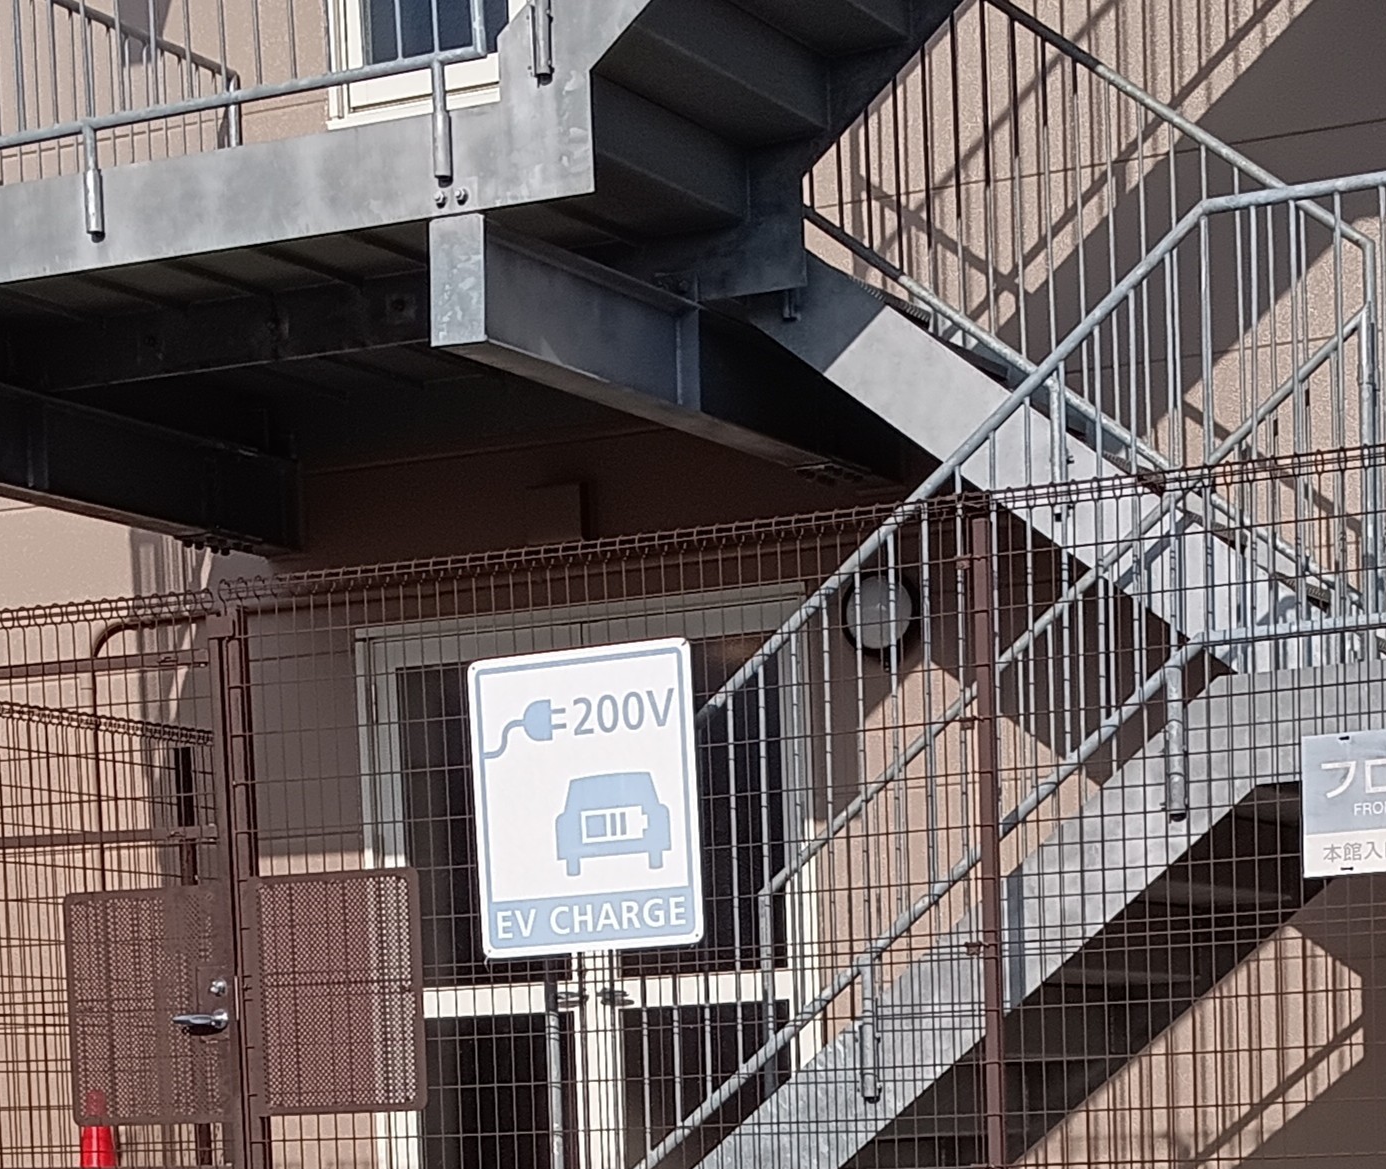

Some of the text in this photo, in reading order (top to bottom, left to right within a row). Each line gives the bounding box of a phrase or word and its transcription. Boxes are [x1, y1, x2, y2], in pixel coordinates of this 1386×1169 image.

[572, 687, 675, 736] 200V
[496, 896, 687, 940] EV CHARGE
